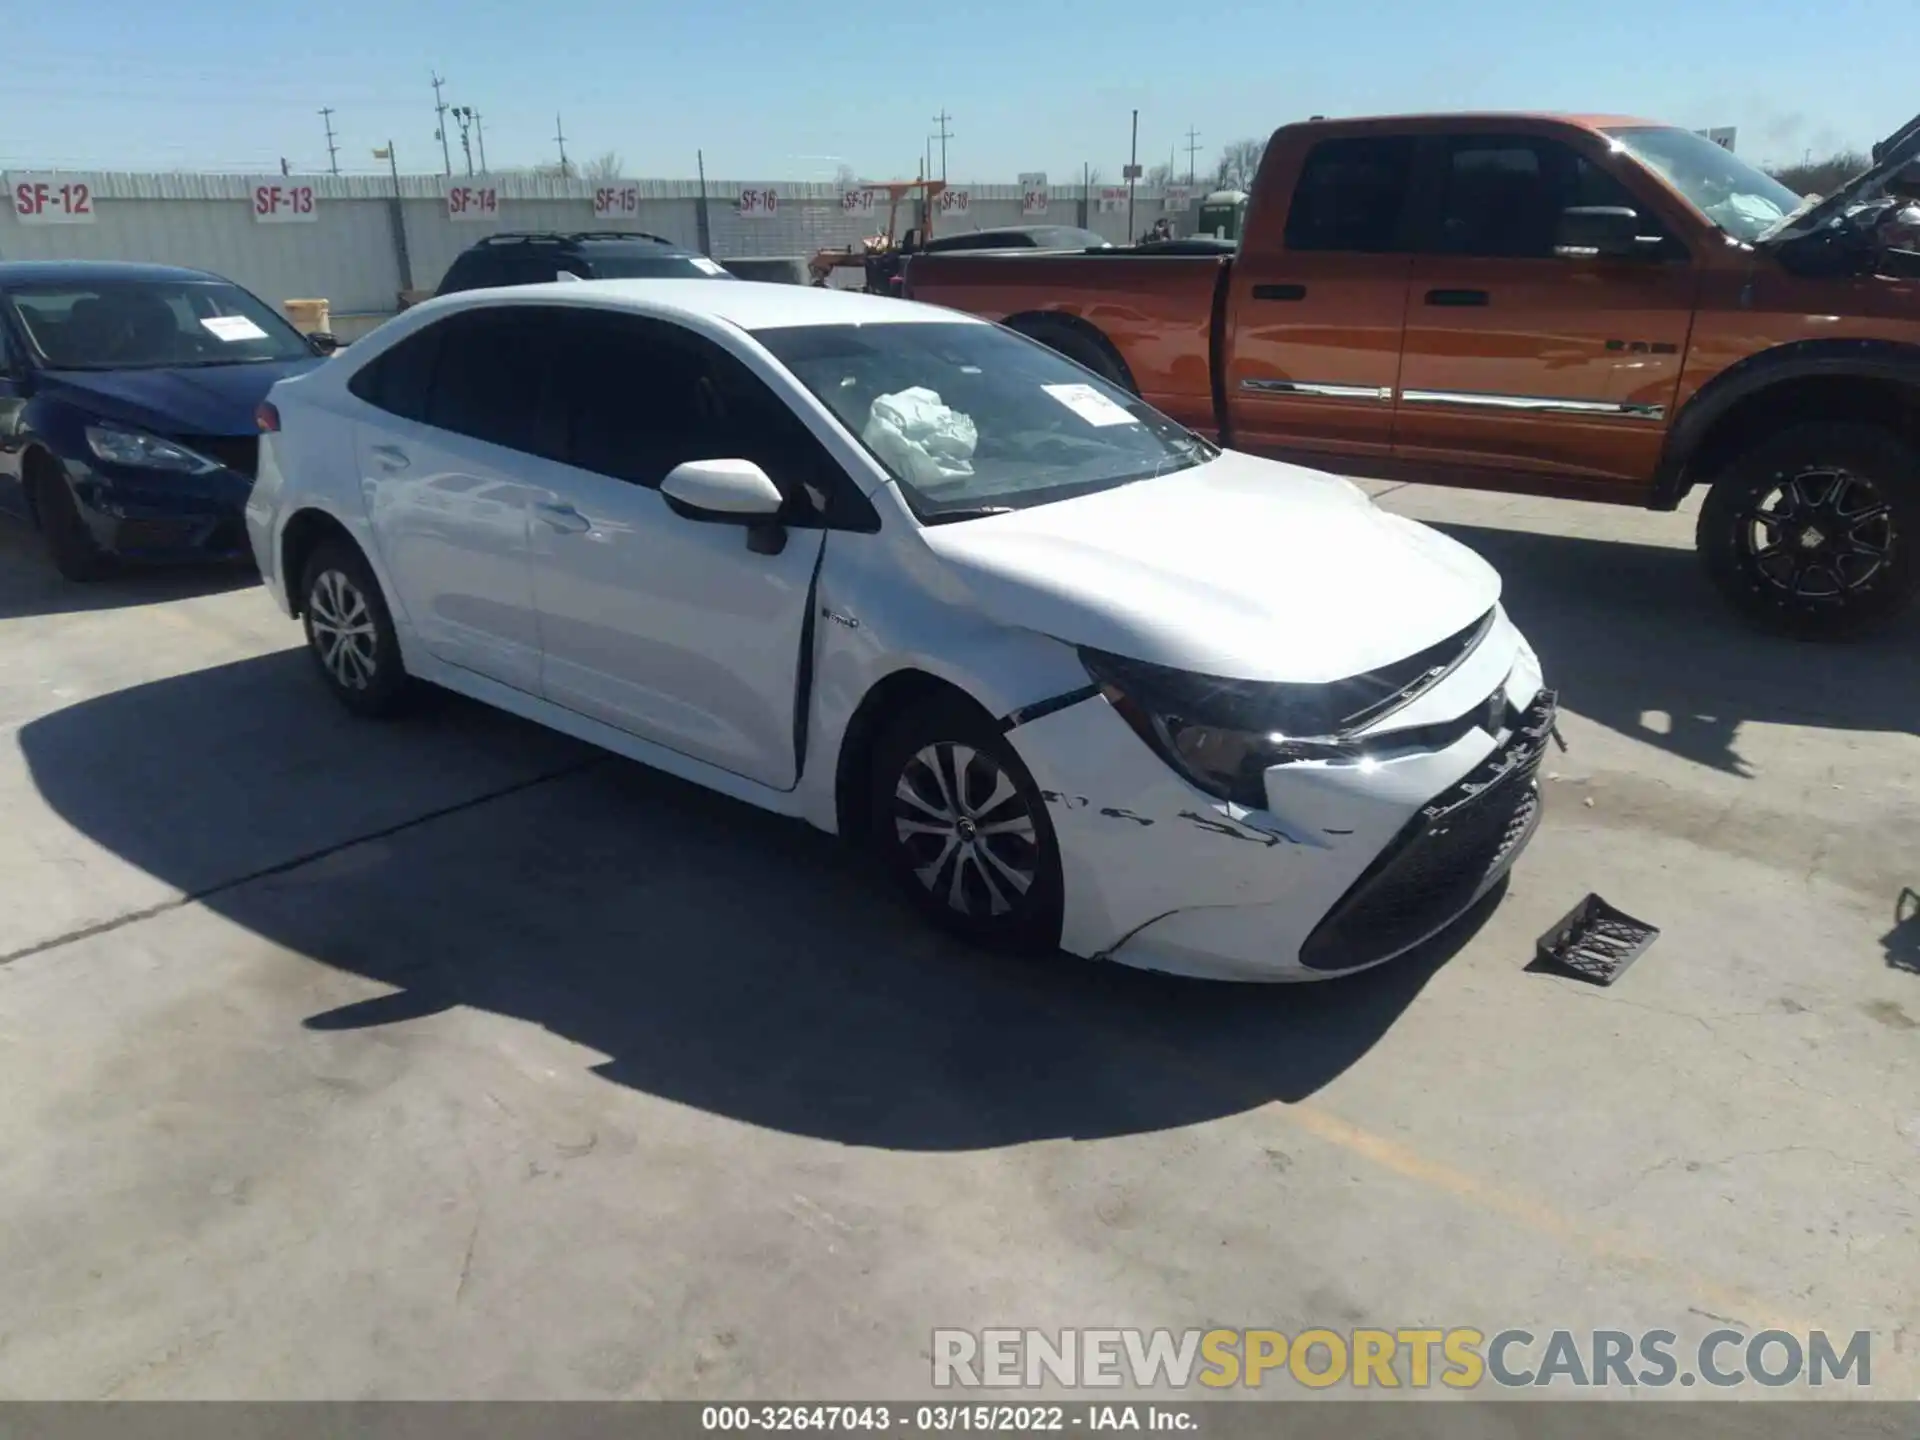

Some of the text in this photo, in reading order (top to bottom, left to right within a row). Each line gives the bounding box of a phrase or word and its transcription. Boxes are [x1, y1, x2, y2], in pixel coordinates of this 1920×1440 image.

[16, 183, 90, 214] SF-12
[256, 186, 313, 214] SF-13
[450, 187, 497, 213] SF-14
[594, 187, 636, 212] SF-15
[741, 188, 776, 211] SF-16
[844, 191, 875, 210] SF-17
[941, 191, 969, 211] SF-18
